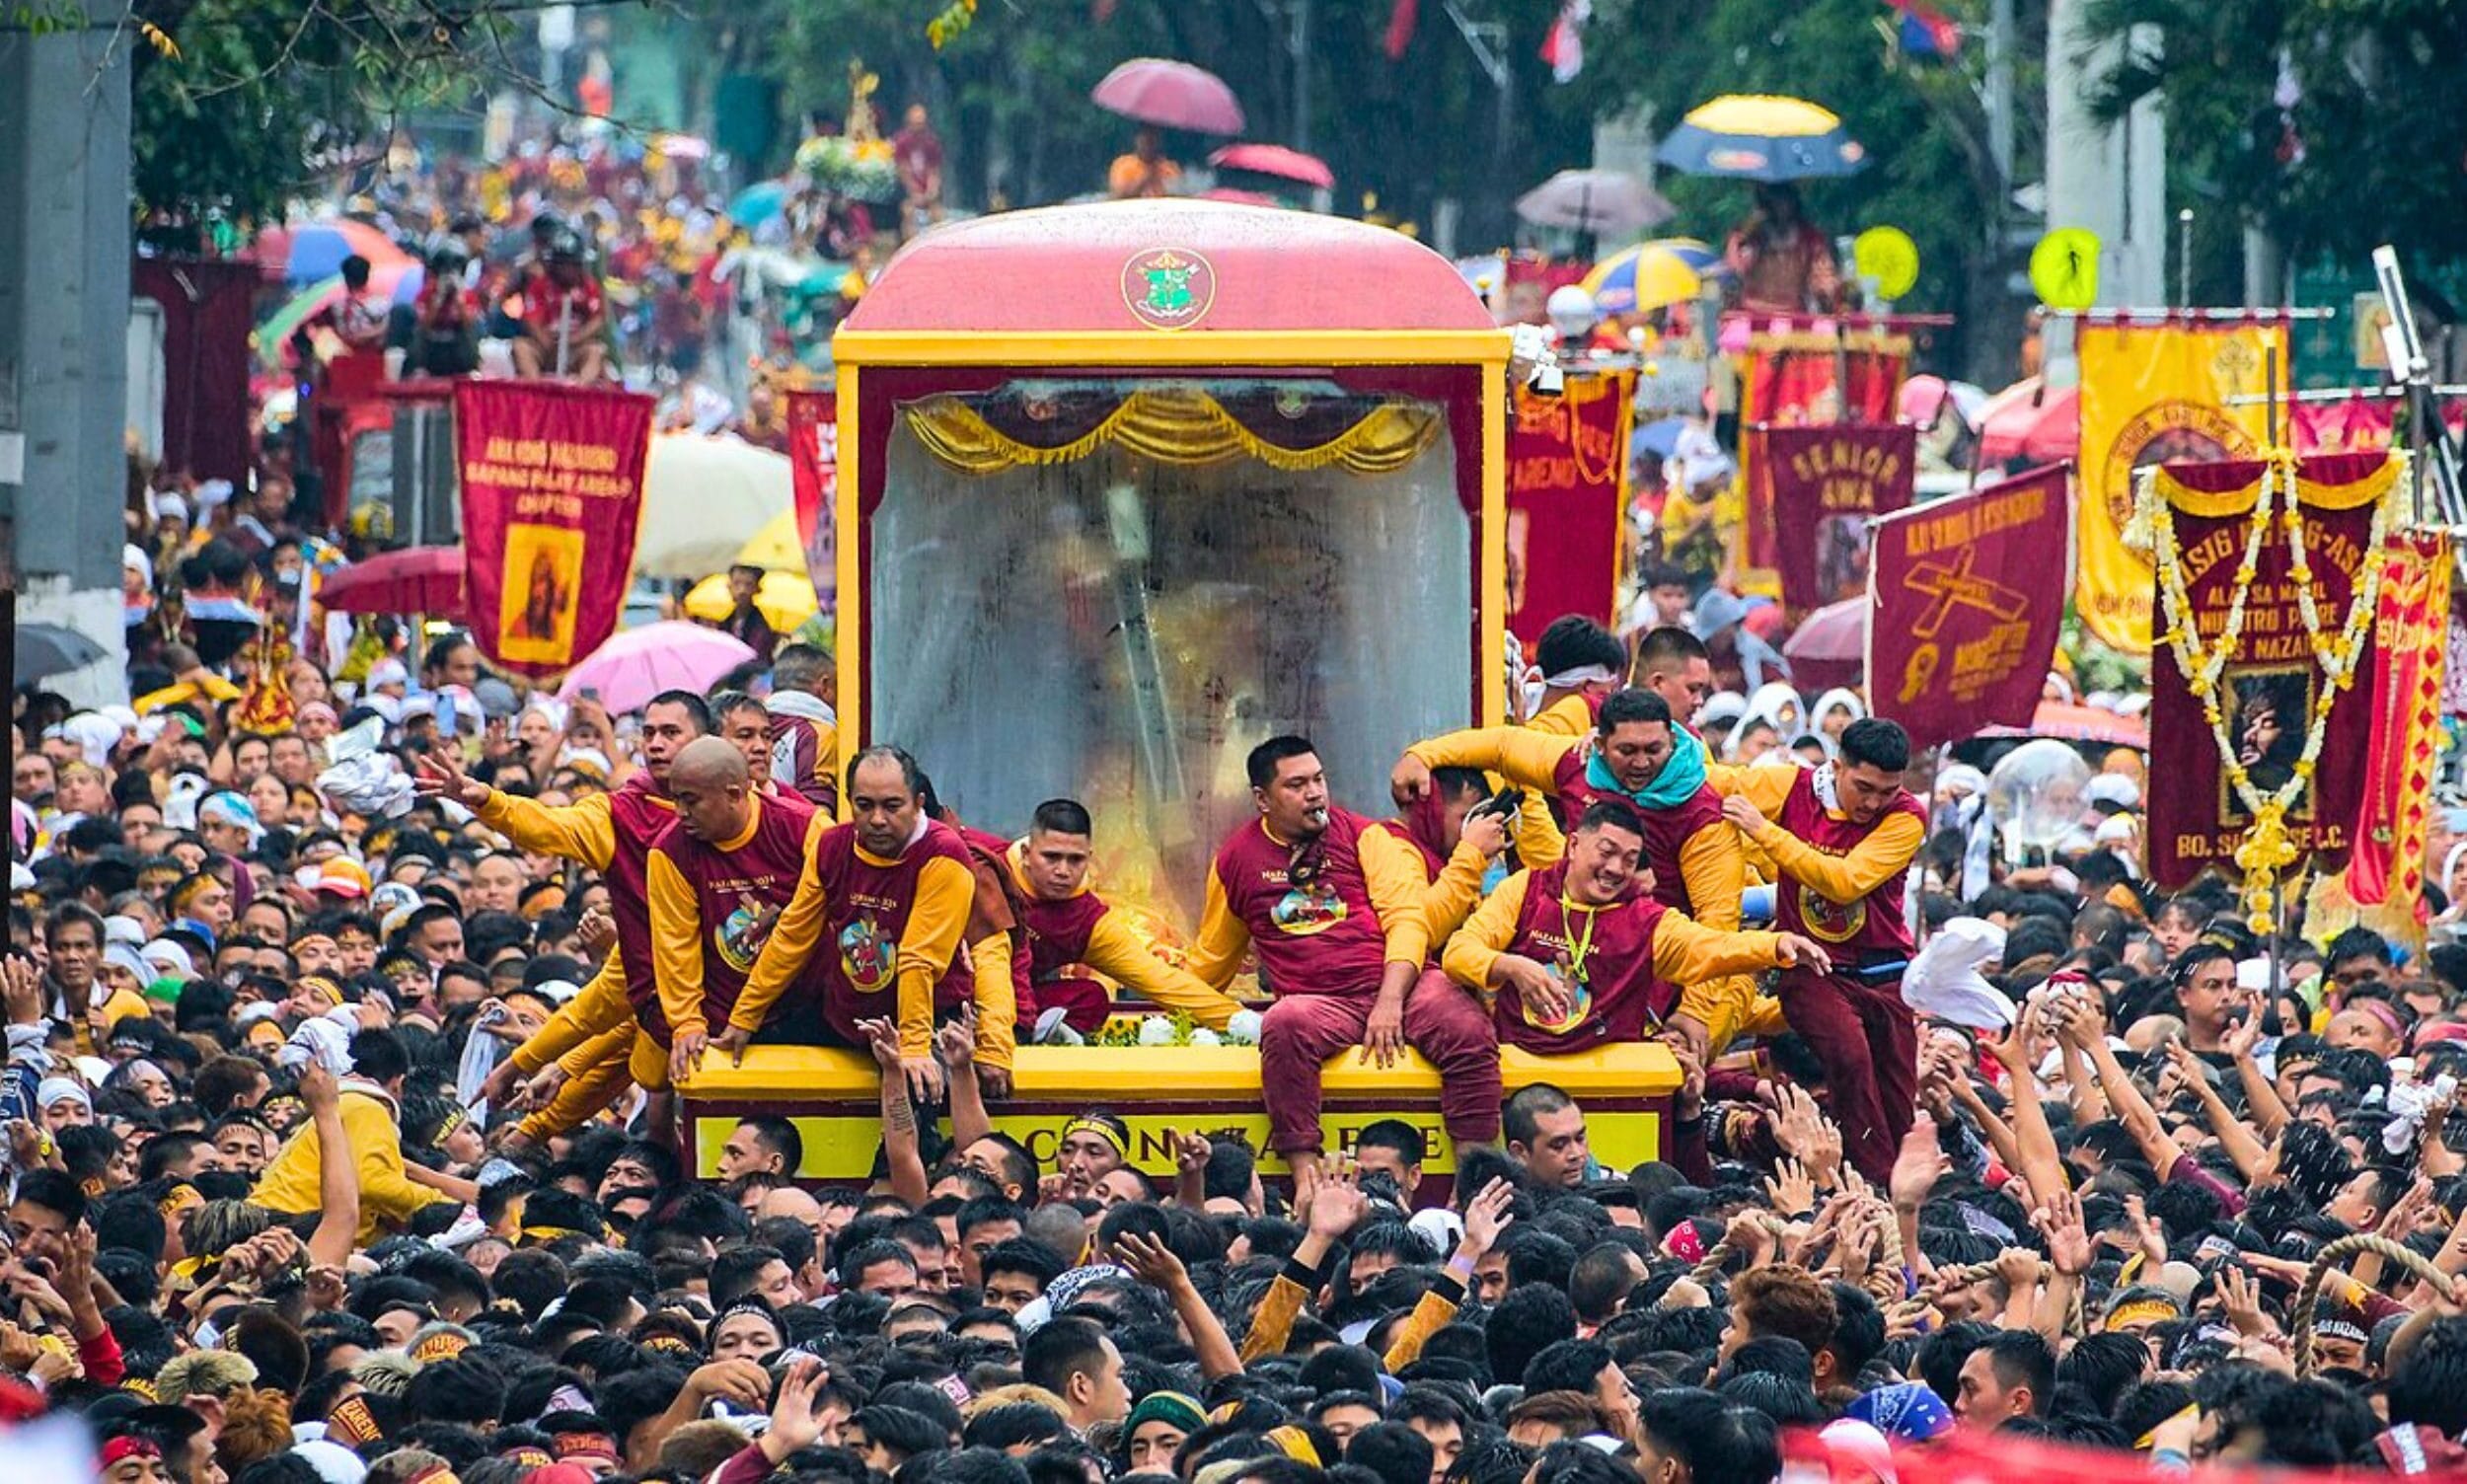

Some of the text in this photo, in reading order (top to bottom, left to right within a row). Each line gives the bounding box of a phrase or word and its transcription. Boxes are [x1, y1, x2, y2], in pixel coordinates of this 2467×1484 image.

[1792, 438, 1900, 484] SENIOR
[2178, 527, 2233, 586] ISIG
[2251, 583, 2273, 604] SA
[2200, 602, 2337, 633] NUTRO PRE
[2176, 834, 2212, 857] BO.
